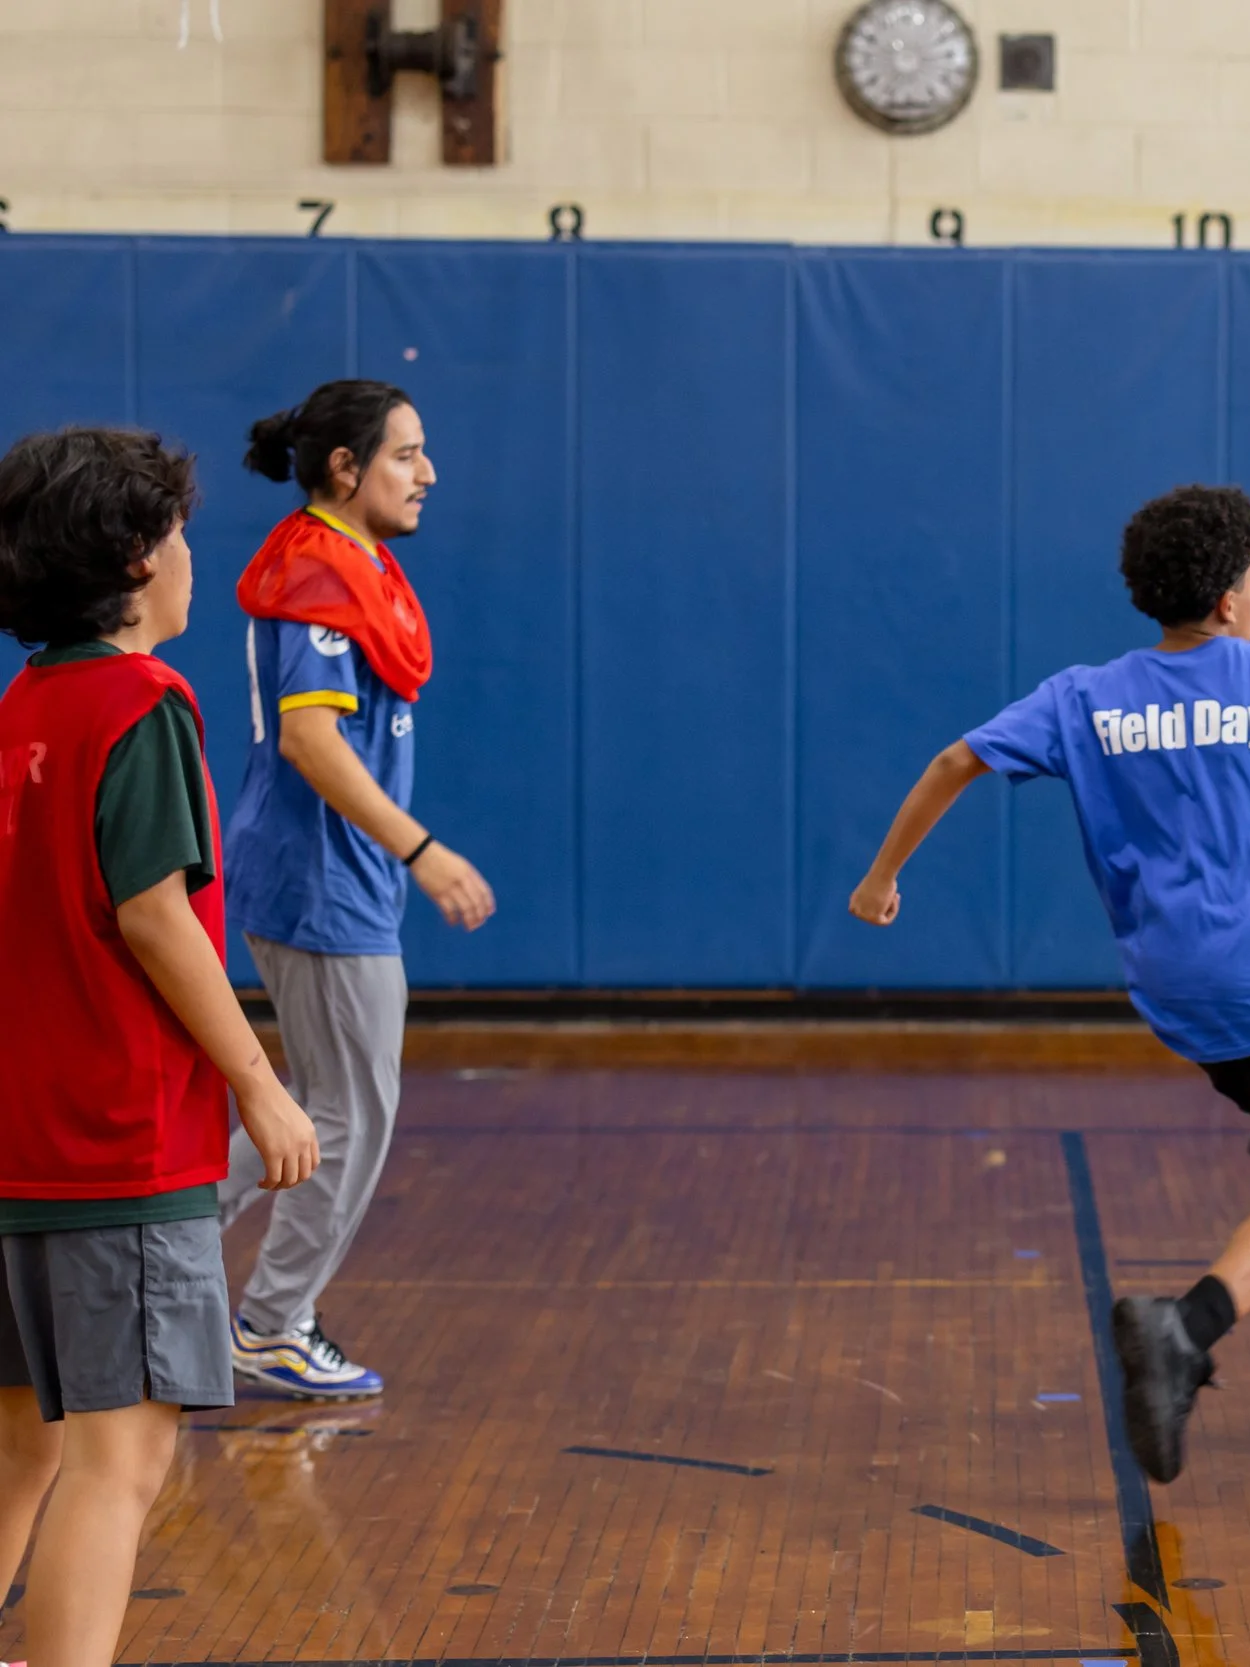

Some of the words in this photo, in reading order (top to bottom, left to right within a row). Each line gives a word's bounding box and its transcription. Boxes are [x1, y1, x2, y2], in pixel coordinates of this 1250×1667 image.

[298, 199, 334, 237] 7
[930, 208, 963, 246] 9
[1172, 212, 1232, 249] 10
[1093, 703, 1187, 756] Field
